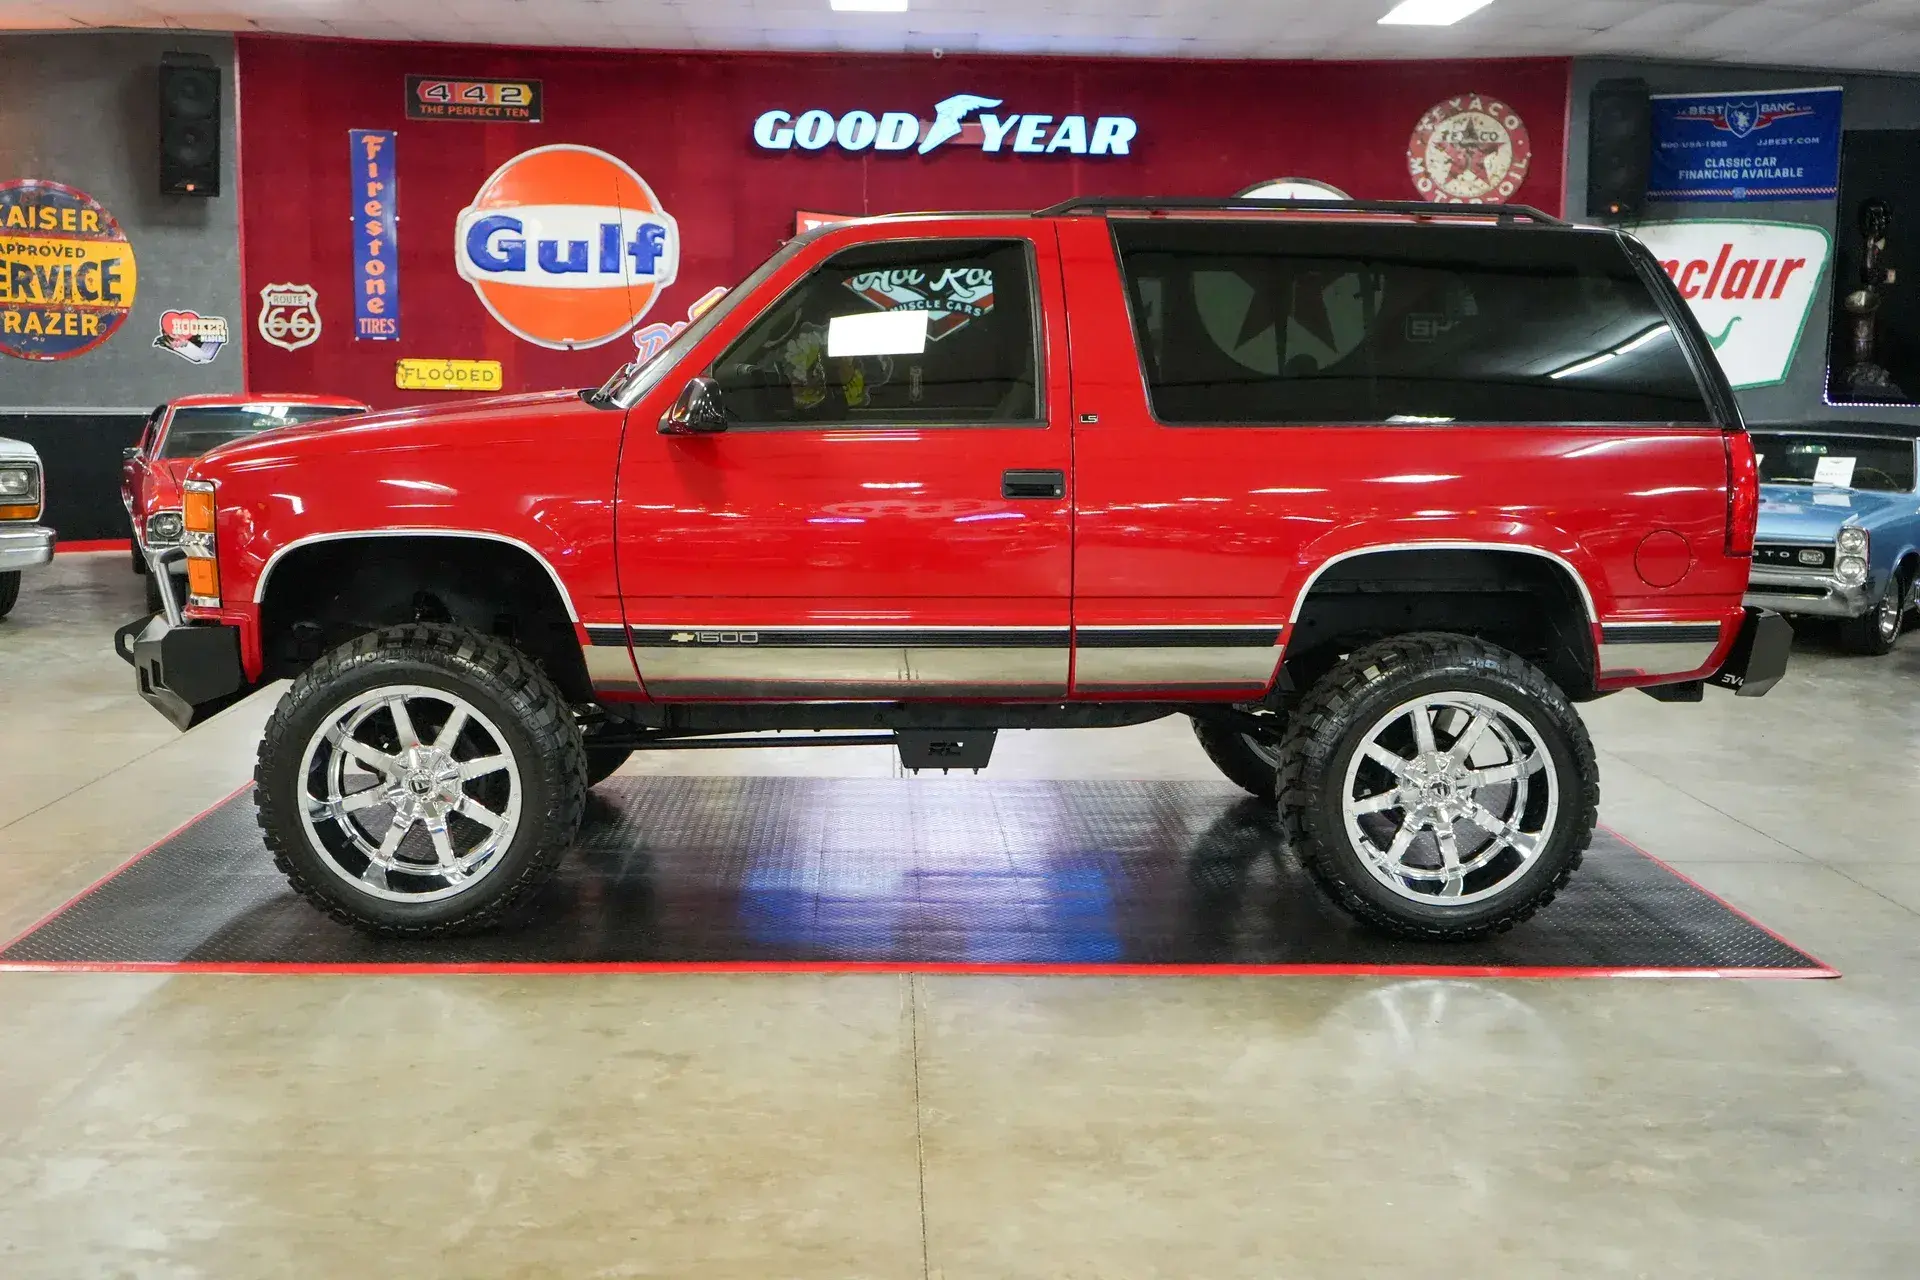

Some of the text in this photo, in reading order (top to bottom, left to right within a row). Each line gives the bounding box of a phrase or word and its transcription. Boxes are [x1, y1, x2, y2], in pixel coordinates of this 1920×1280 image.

[420, 104, 529, 117] THE PERFECT TEN
[1689, 105, 1724, 115] BEST
[1761, 102, 1796, 113] BANC
[1757, 137, 1819, 147] JJBEST.COM
[1705, 156, 1777, 168] CLASSIC CAR
[1679, 167, 1804, 180] FINANCING AVAILABLE
[0, 205, 99, 232] AISER
[362, 135, 386, 314] Firestone
[466, 215, 666, 275] Gulf
[273, 295, 303, 304] ROUTE
[946, 301, 982, 317] CARS
[171, 319, 226, 336] HOOKER
[268, 307, 310, 338] 66
[359, 318, 395, 335] TIRES
[404, 368, 494, 382] FLOODED
[1080, 415, 1098, 423] LS
[694, 631, 759, 643] 1500
